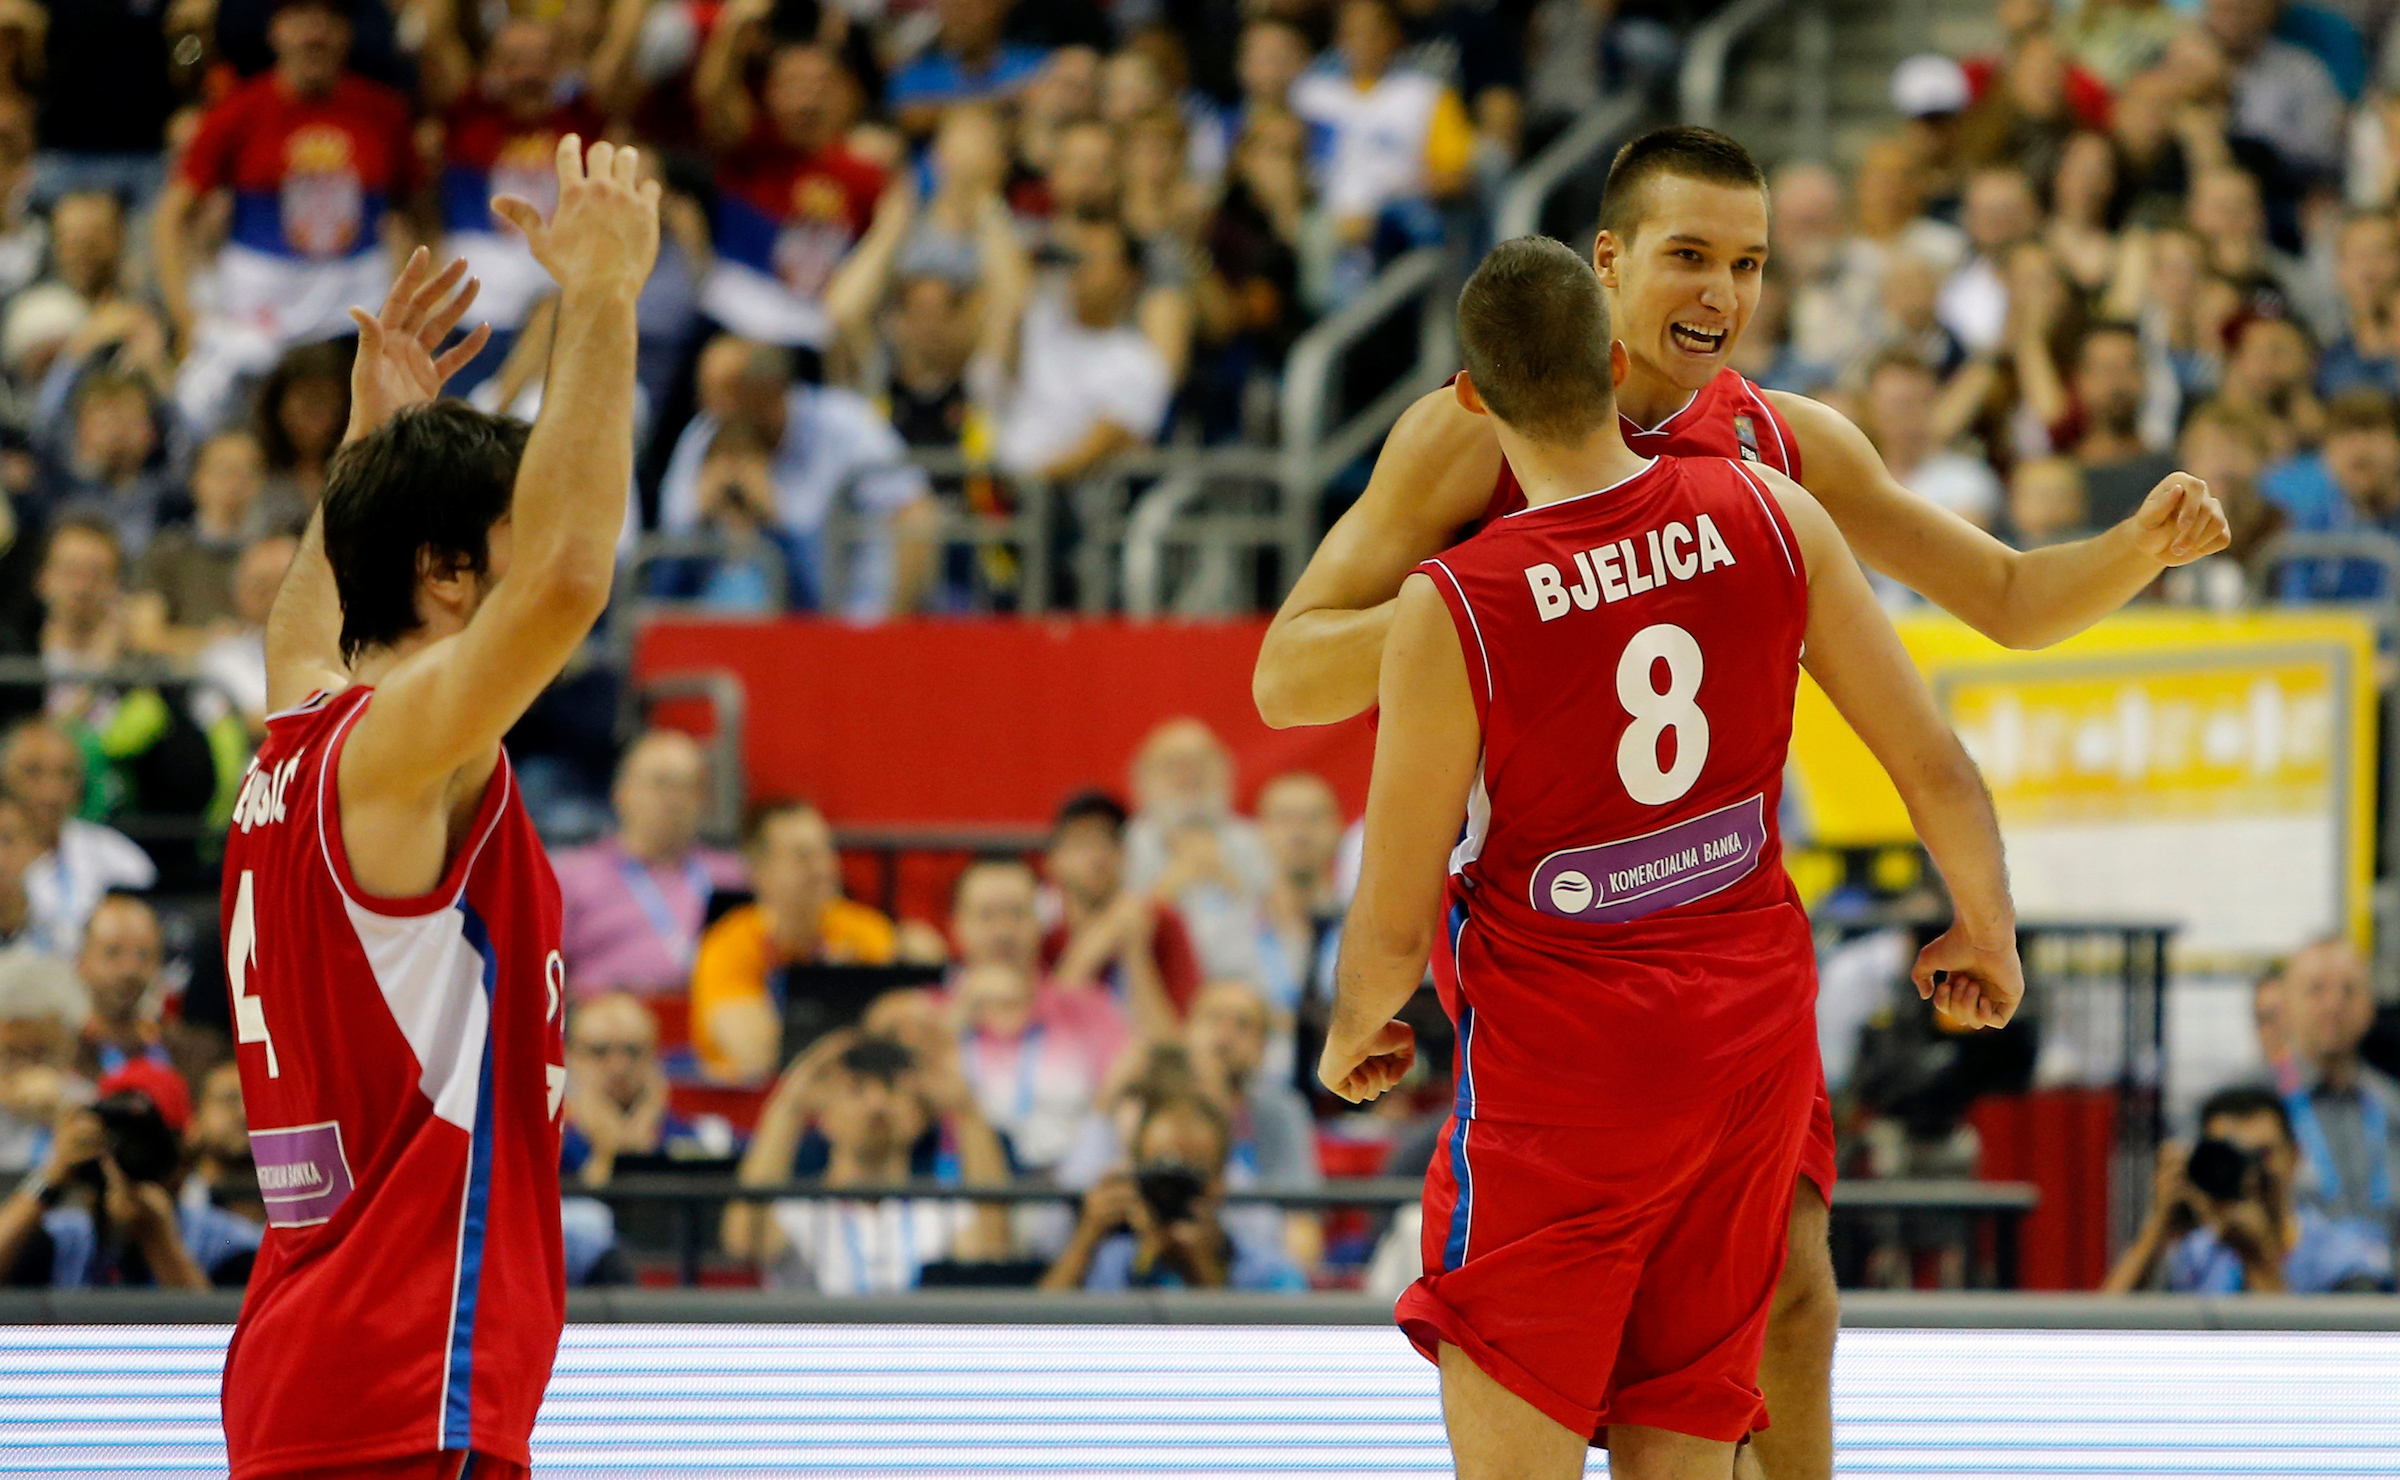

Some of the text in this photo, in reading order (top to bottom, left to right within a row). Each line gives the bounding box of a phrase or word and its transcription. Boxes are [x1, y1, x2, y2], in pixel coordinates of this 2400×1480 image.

[1524, 513, 1736, 622] BJELICA
[1615, 623, 1710, 806] 8
[1608, 831, 1743, 894] KOMERCIJALNA BANKA
[227, 869, 280, 1079] 4
